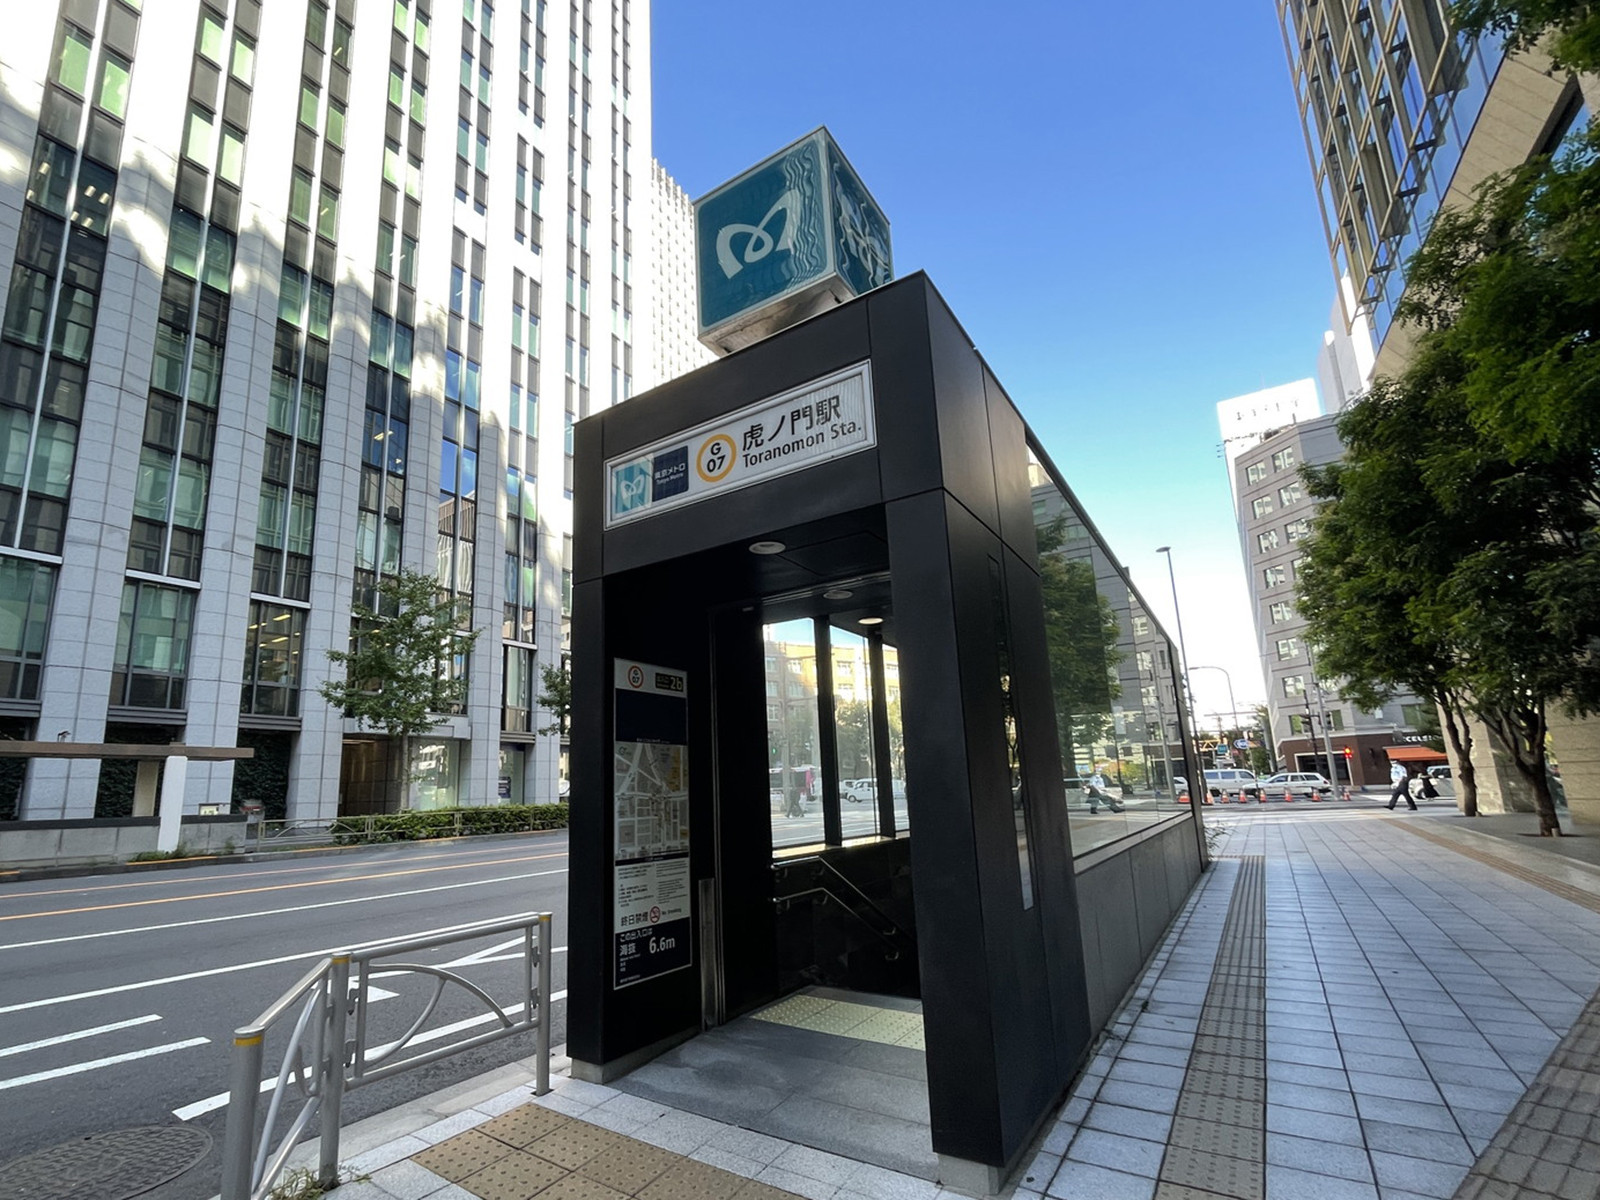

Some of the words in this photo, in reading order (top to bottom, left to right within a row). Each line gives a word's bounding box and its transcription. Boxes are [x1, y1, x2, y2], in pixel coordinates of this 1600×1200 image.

[742, 395, 841, 451] 虎ノ門駅
[710, 442, 722, 456] G
[742, 432, 825, 468] Toranomon
[830, 421, 861, 440] Sta.
[707, 455, 726, 473] 07
[649, 936, 676, 955] 6.6m
